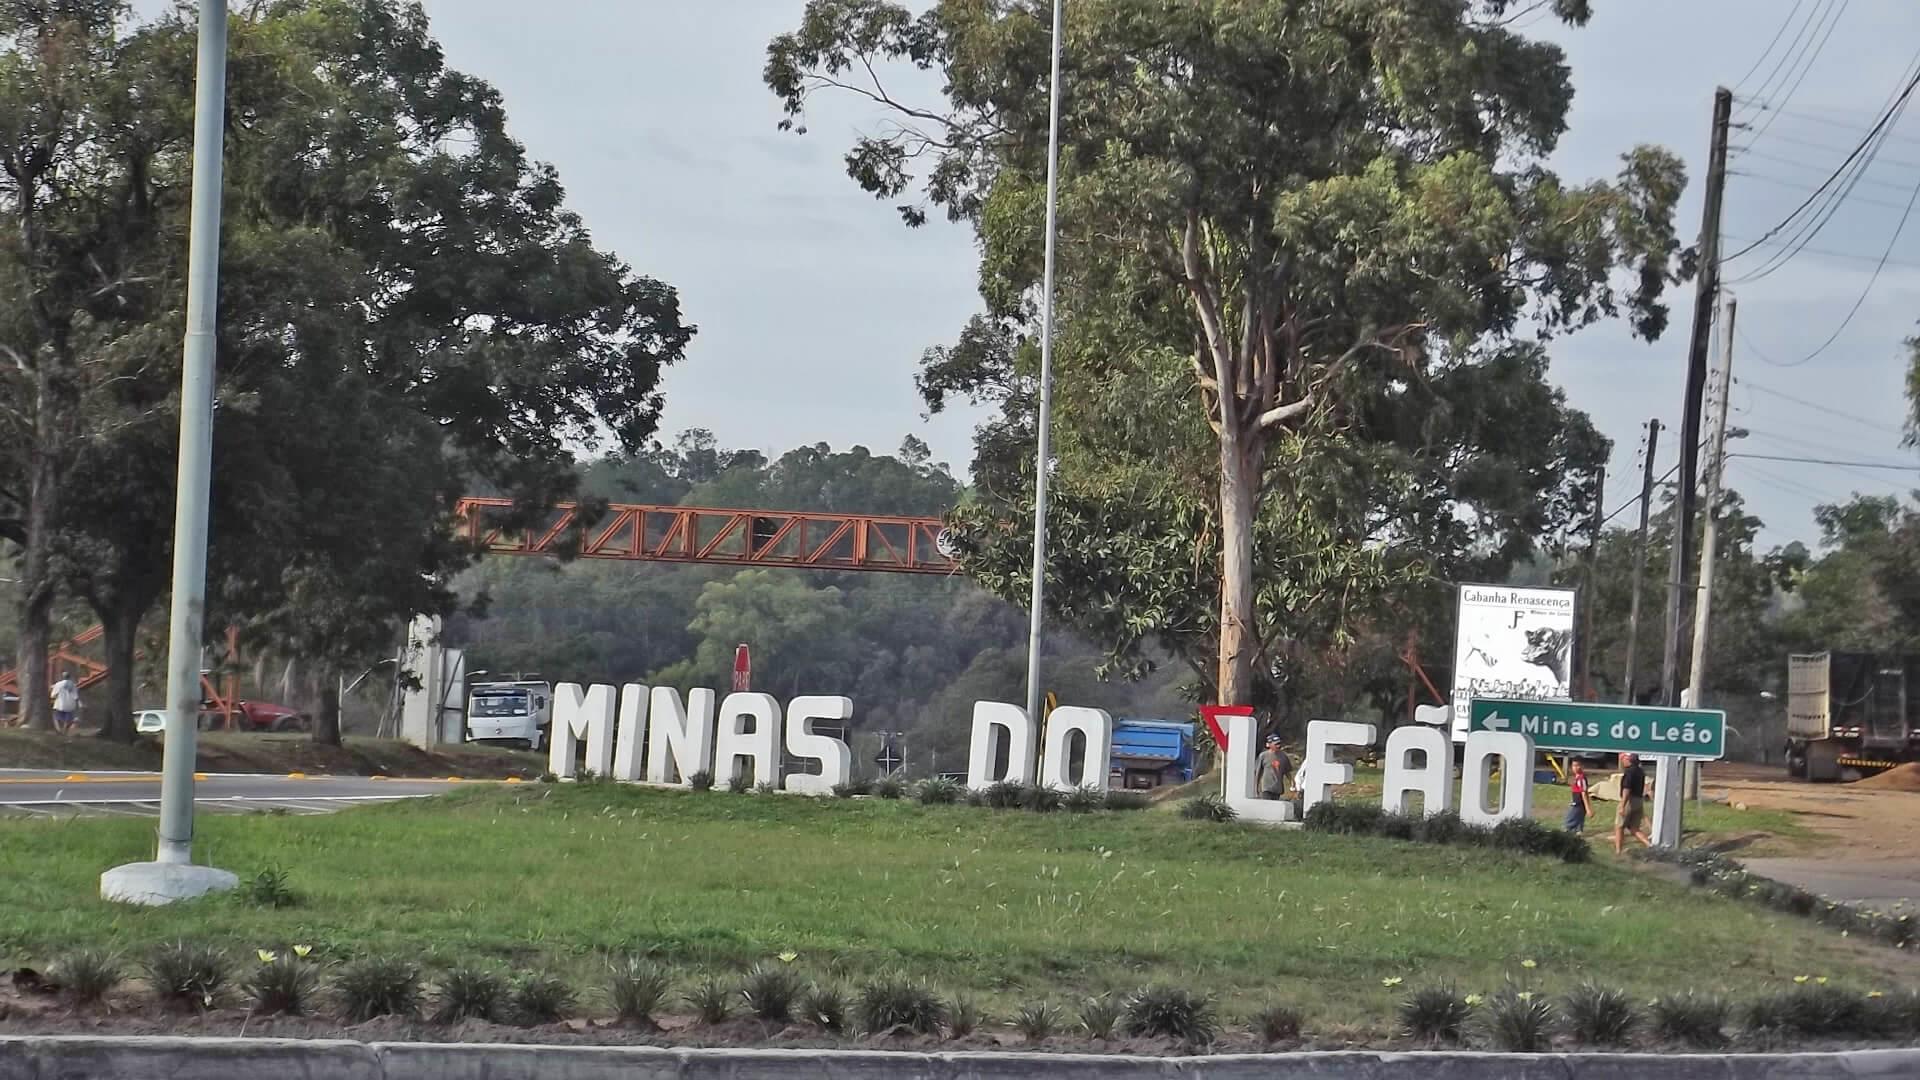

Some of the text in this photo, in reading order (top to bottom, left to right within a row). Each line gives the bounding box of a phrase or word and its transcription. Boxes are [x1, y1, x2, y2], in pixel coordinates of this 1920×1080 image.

[1464, 589, 1570, 608] Cabanha Renascença
[1520, 714, 1713, 744] Minas do Leão
[549, 682, 1535, 826] MINAS DO LEÃO
